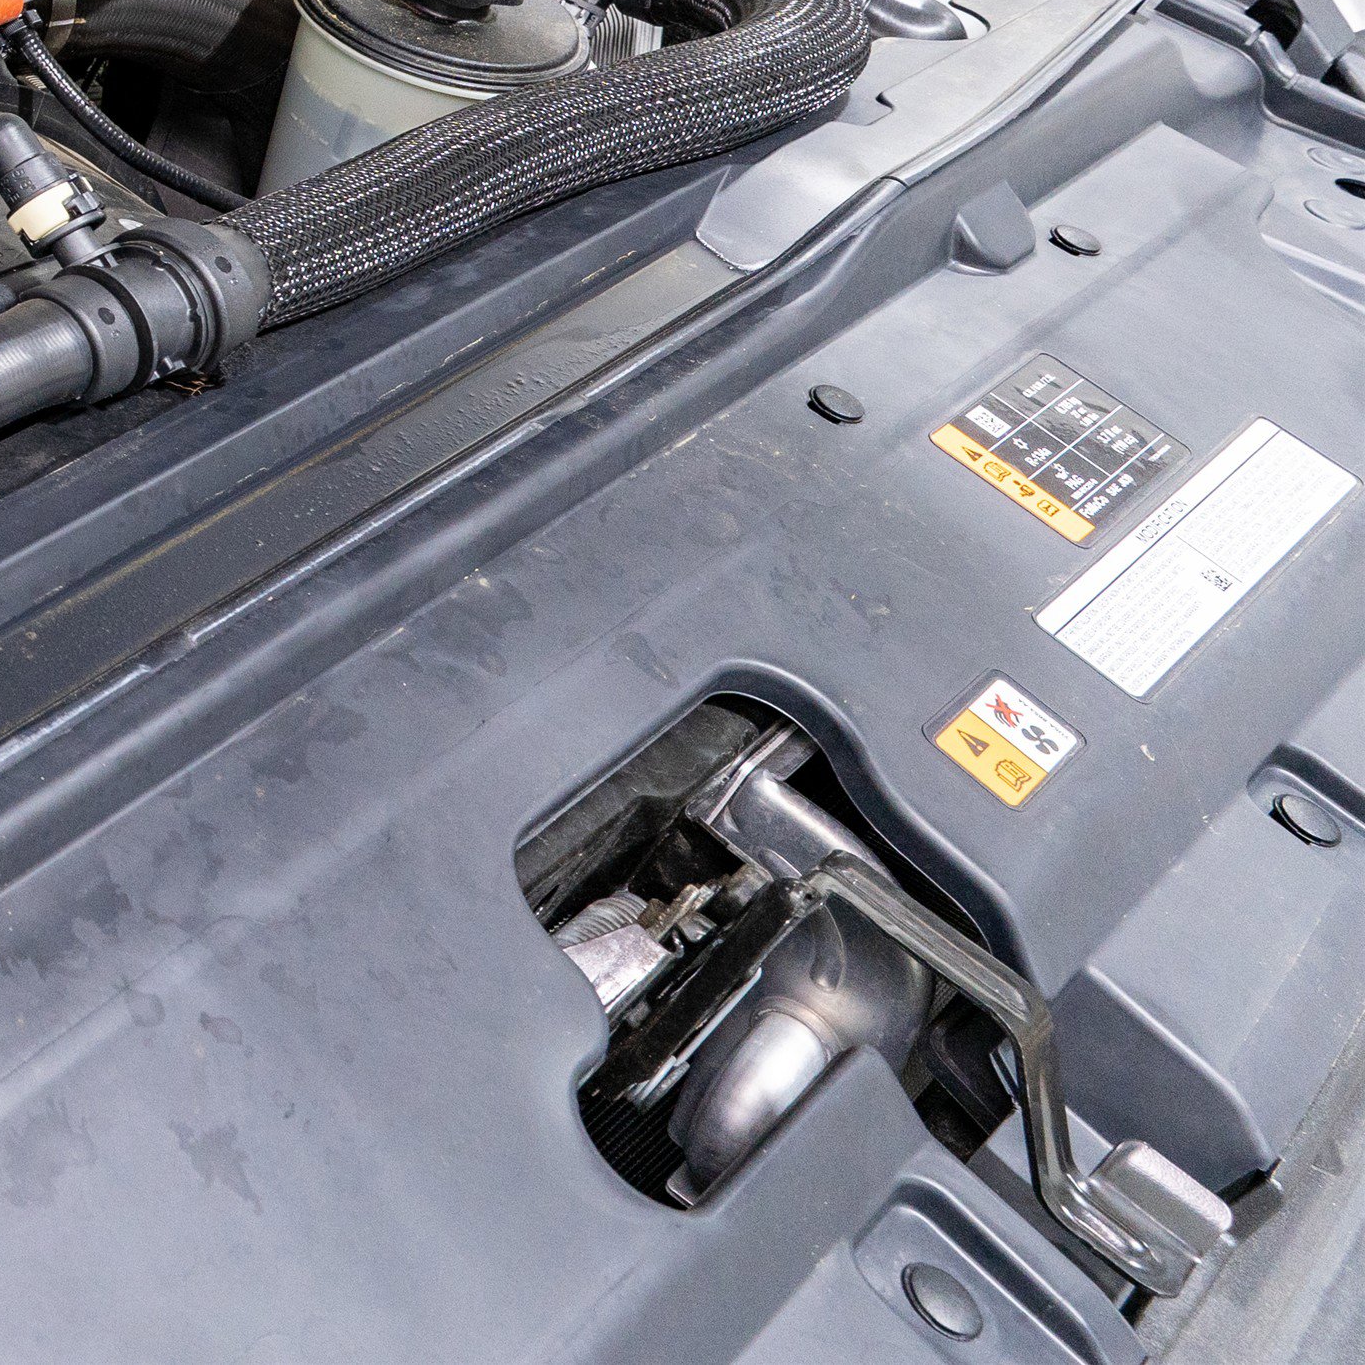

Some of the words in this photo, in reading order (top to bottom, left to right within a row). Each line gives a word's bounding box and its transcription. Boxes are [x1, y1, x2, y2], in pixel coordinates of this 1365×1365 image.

[1023, 444, 1053, 467] R-134a
[1063, 473, 1085, 490] PAG
[1077, 492, 1110, 519] FoMoCo
[1104, 482, 1123, 497] SAE
[1133, 497, 1190, 545] MODIFICATION
